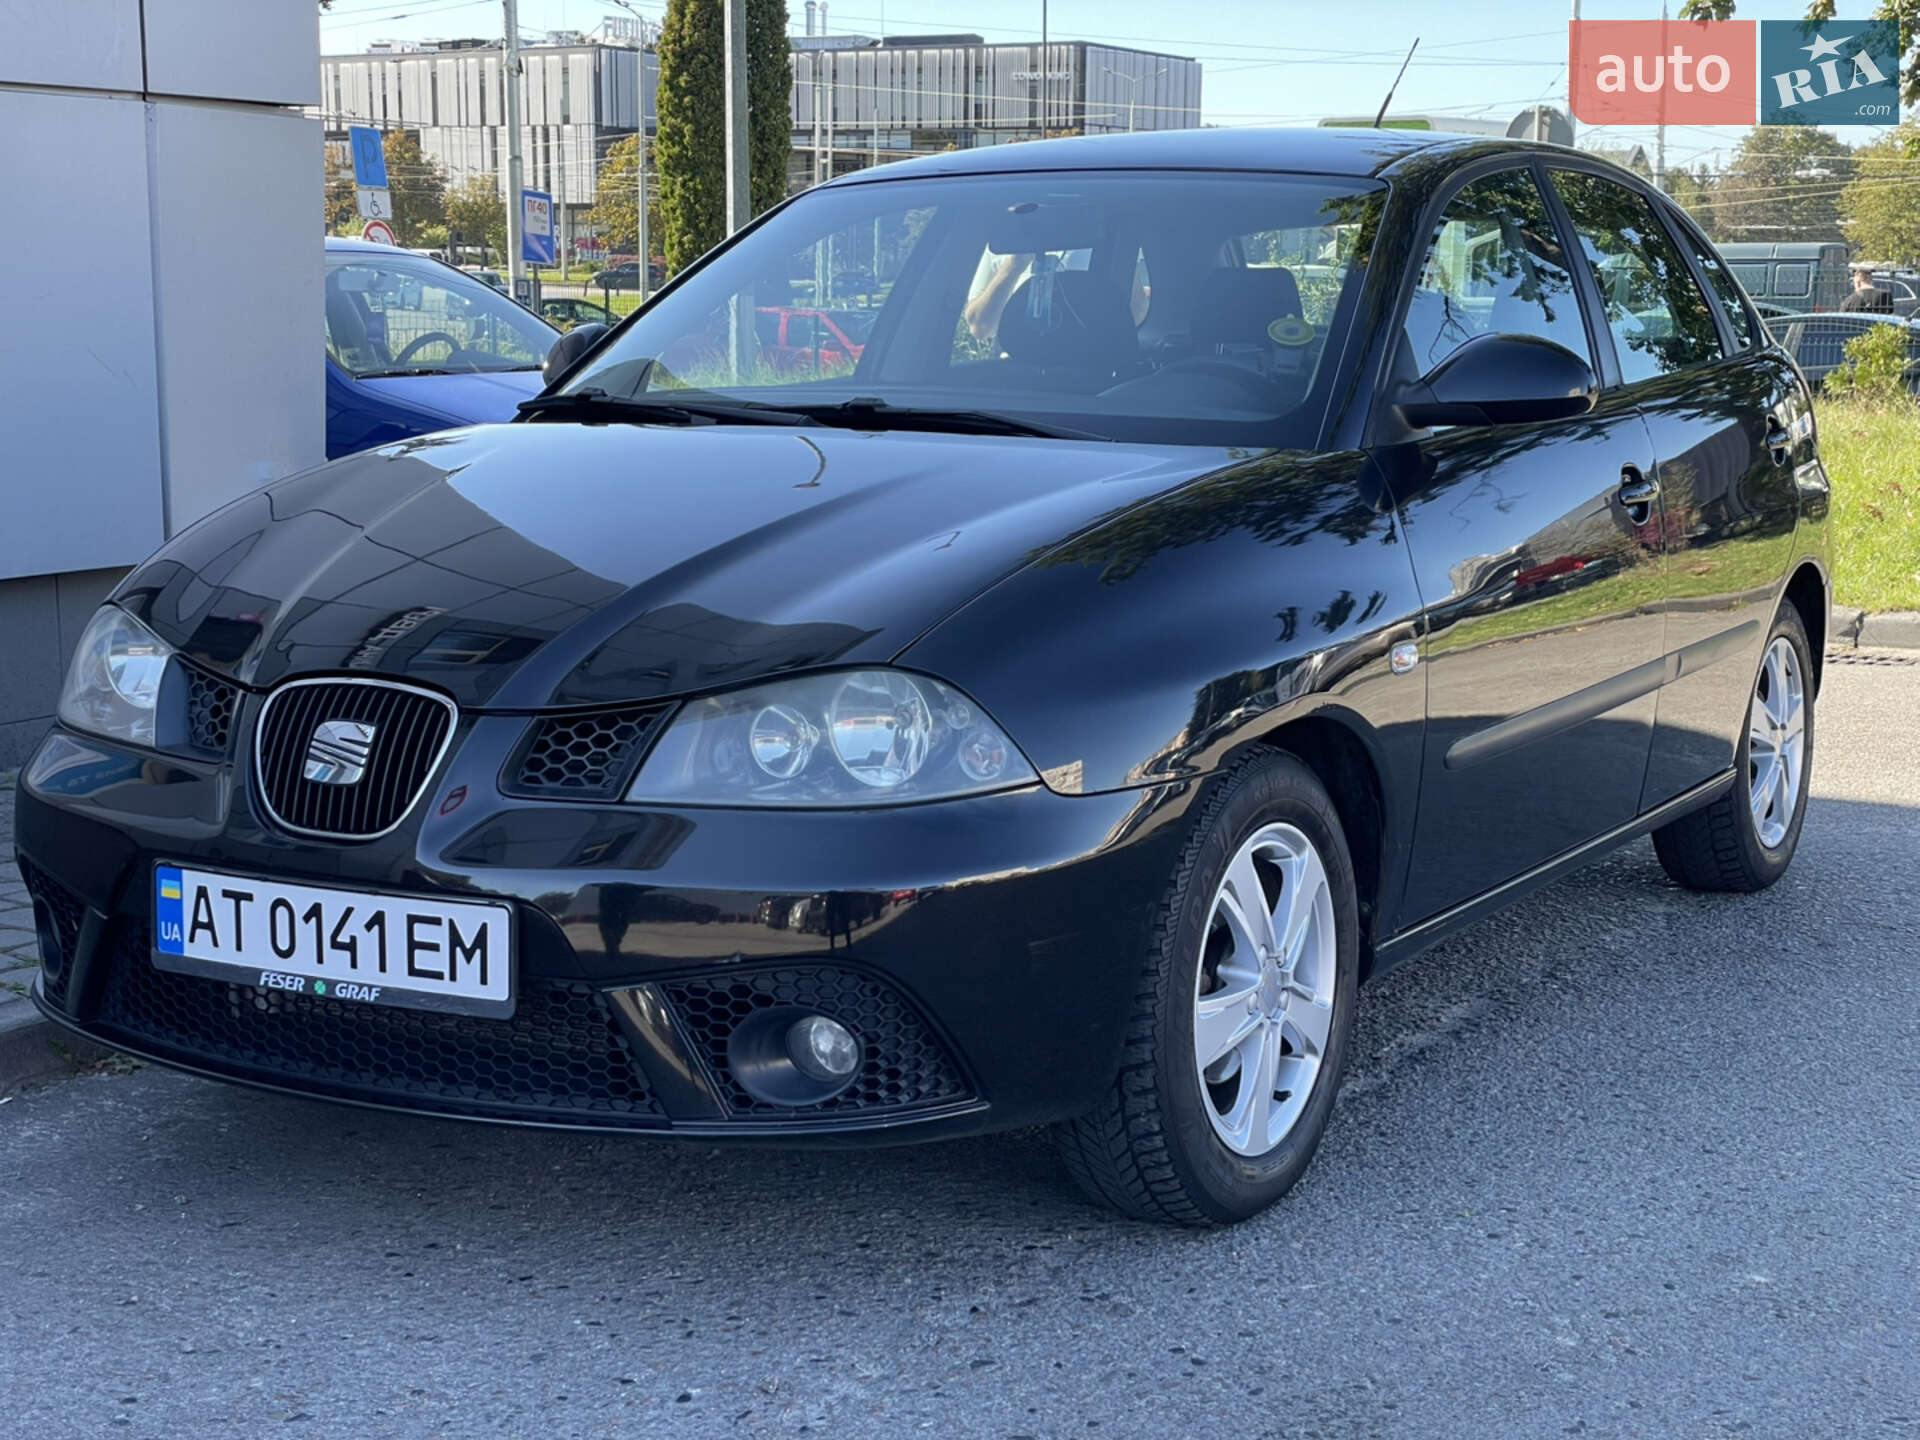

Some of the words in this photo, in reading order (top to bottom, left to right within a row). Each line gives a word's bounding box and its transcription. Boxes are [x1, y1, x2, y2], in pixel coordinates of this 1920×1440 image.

[161, 921, 182, 942] UA
[188, 885, 254, 952] AT
[269, 897, 387, 973] 0141
[406, 913, 488, 986] EM
[260, 971, 305, 993] FESER
[335, 983, 382, 1002] GRAF
